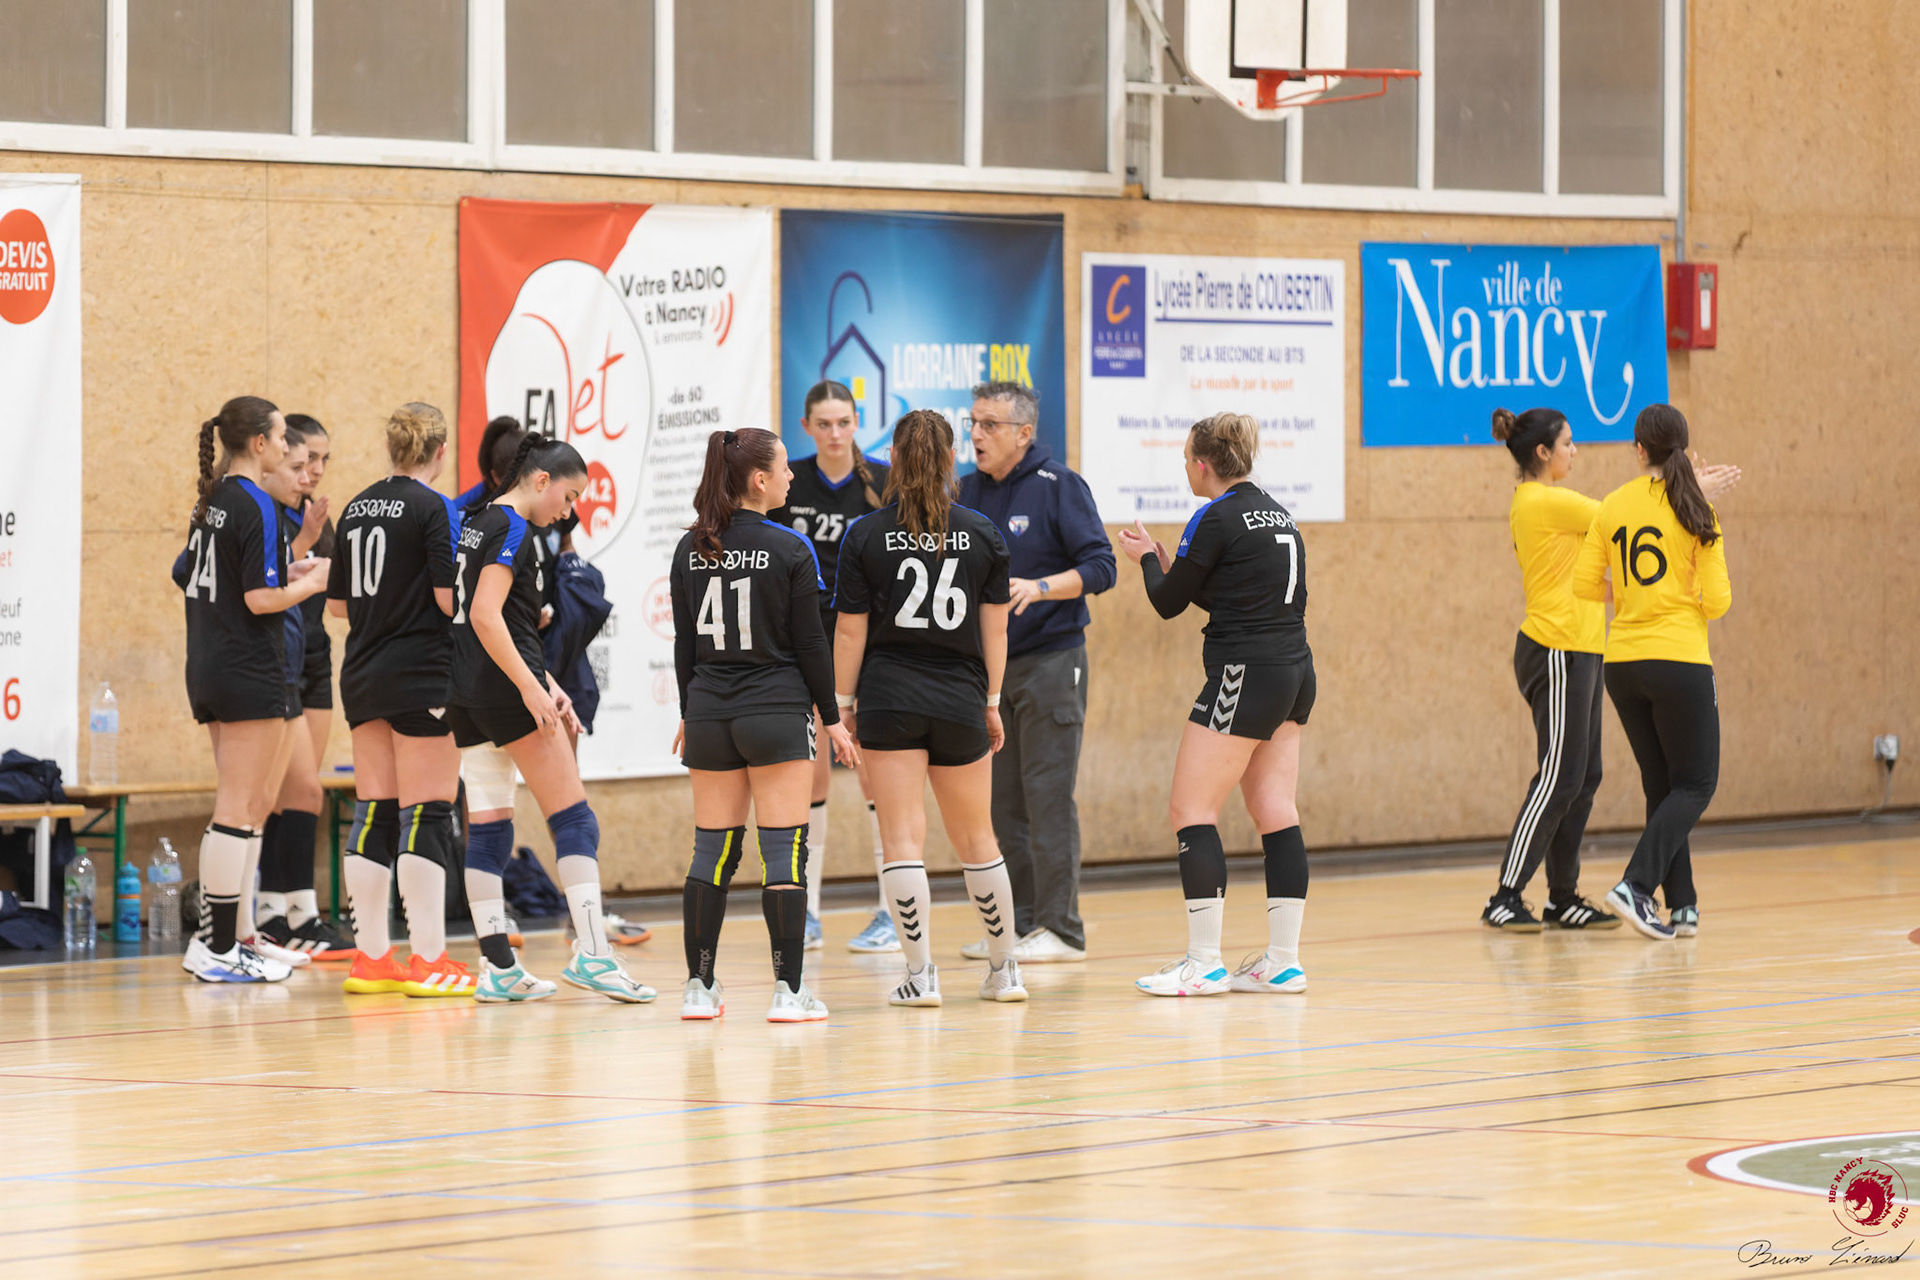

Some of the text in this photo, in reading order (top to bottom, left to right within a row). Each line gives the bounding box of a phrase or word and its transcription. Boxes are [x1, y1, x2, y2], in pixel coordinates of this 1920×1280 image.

[620, 265, 726, 298] Votre RADIO
[1154, 268, 1335, 321] Lycée Pierre de COUBERTIN
[1482, 261, 1562, 306] ville de
[656, 302, 706, 328] Nancy
[1387, 258, 1634, 426] Nancy
[893, 343, 1033, 389] LORRAINE BOX
[1180, 344, 1305, 364] DE LA SECONDE AU BTS
[814, 513, 844, 543] 25
[1611, 525, 1668, 588] 16
[185, 528, 217, 603] 24
[346, 525, 387, 598] 10
[1275, 533, 1297, 605] 7
[696, 576, 753, 651] 41
[894, 556, 967, 631] 26
